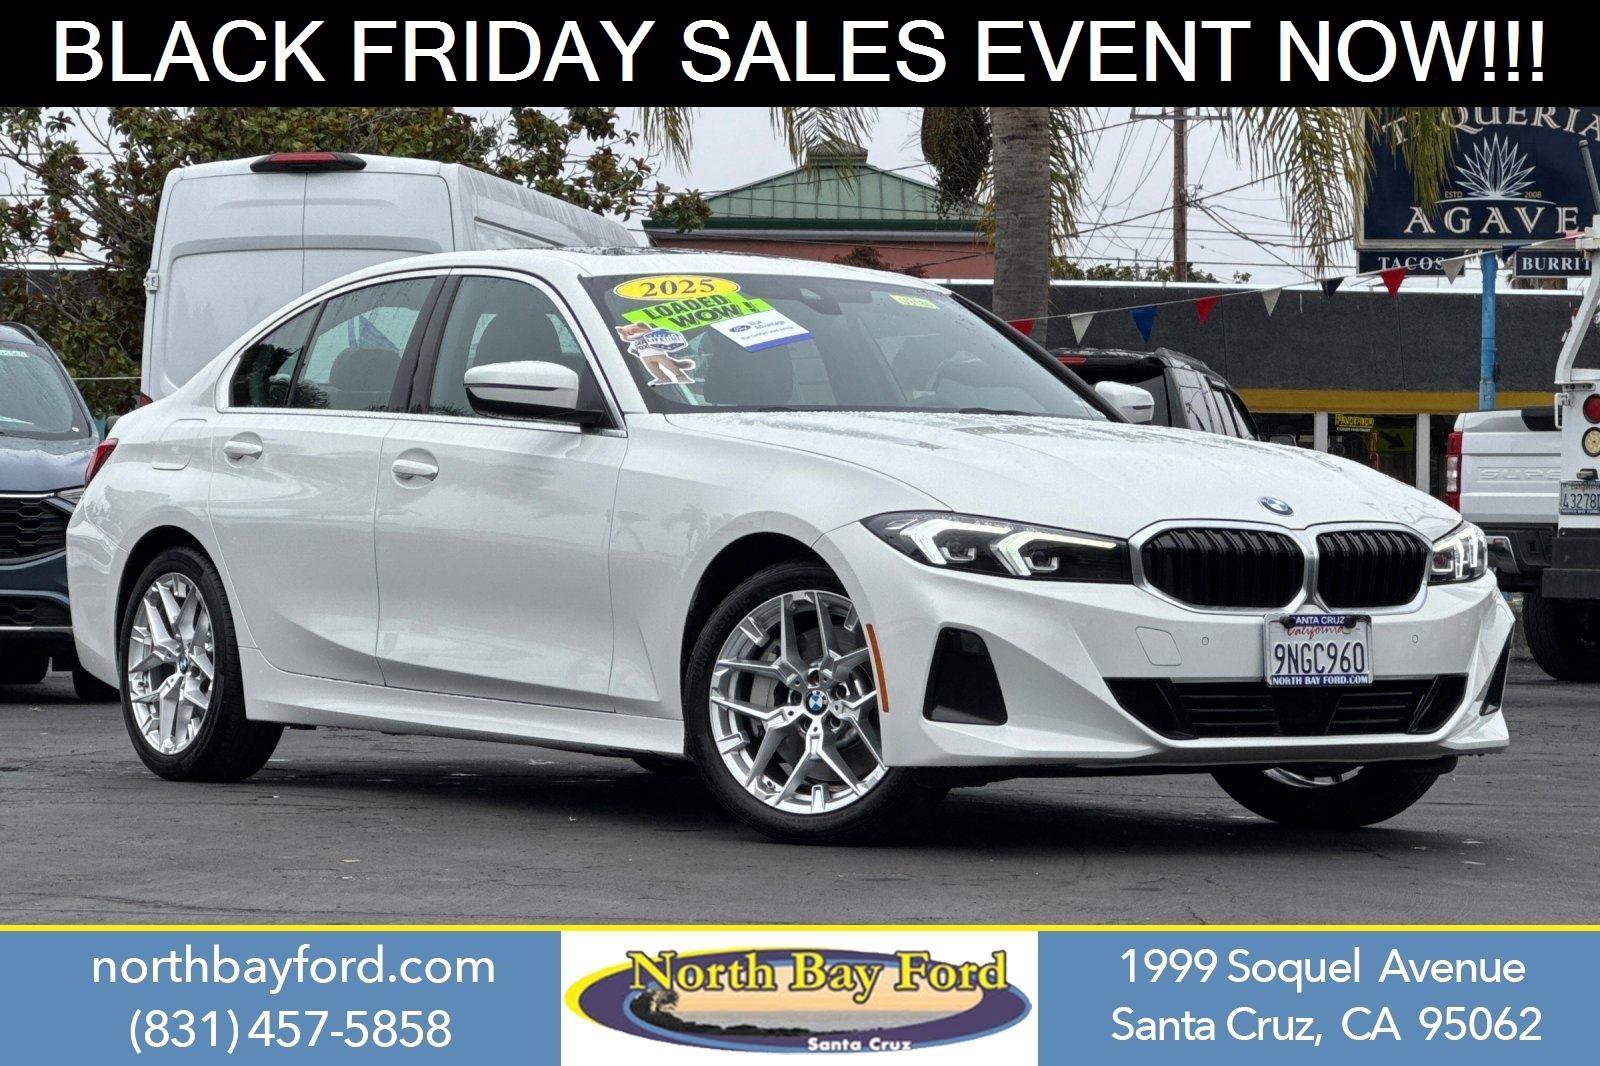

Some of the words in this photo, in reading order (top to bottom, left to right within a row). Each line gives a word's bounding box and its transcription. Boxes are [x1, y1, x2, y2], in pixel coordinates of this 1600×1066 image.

[1403, 206, 1580, 234] AGAVE
[1378, 256, 1445, 272] TACOS
[640, 279, 715, 298] 2025
[642, 294, 729, 320] LOADED
[668, 304, 742, 328] WOW
[1321, 616, 1345, 625] CRUZ
[1274, 642, 1365, 674] 9NGC960
[1273, 676, 1302, 685] NORTH
[1304, 676, 1320, 685] BAY
[1323, 675, 1368, 685] FORD.COM
